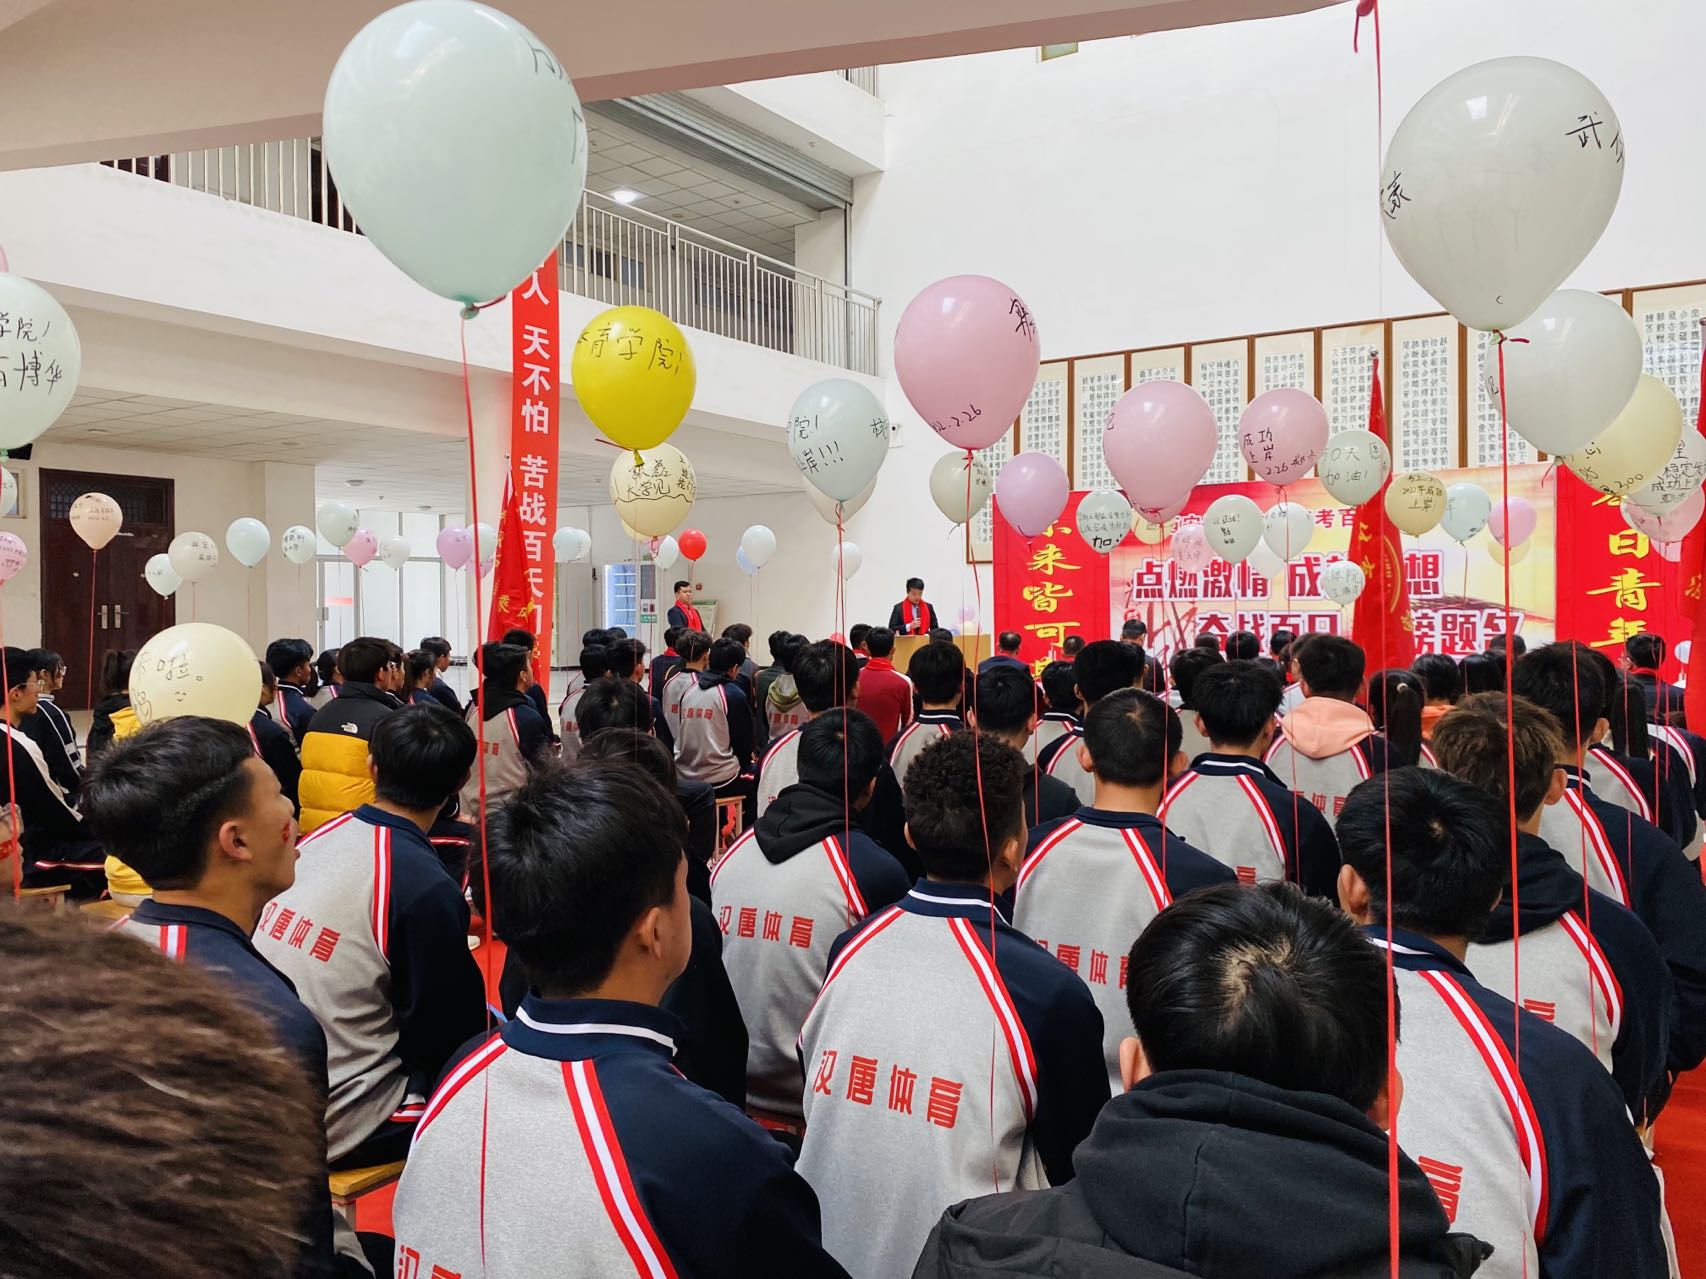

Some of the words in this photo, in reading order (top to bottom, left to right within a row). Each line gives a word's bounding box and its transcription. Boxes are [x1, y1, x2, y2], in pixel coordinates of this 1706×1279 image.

[719, 905, 815, 949] 汉唐体育
[812, 1049, 964, 1129] 汉唐体育
